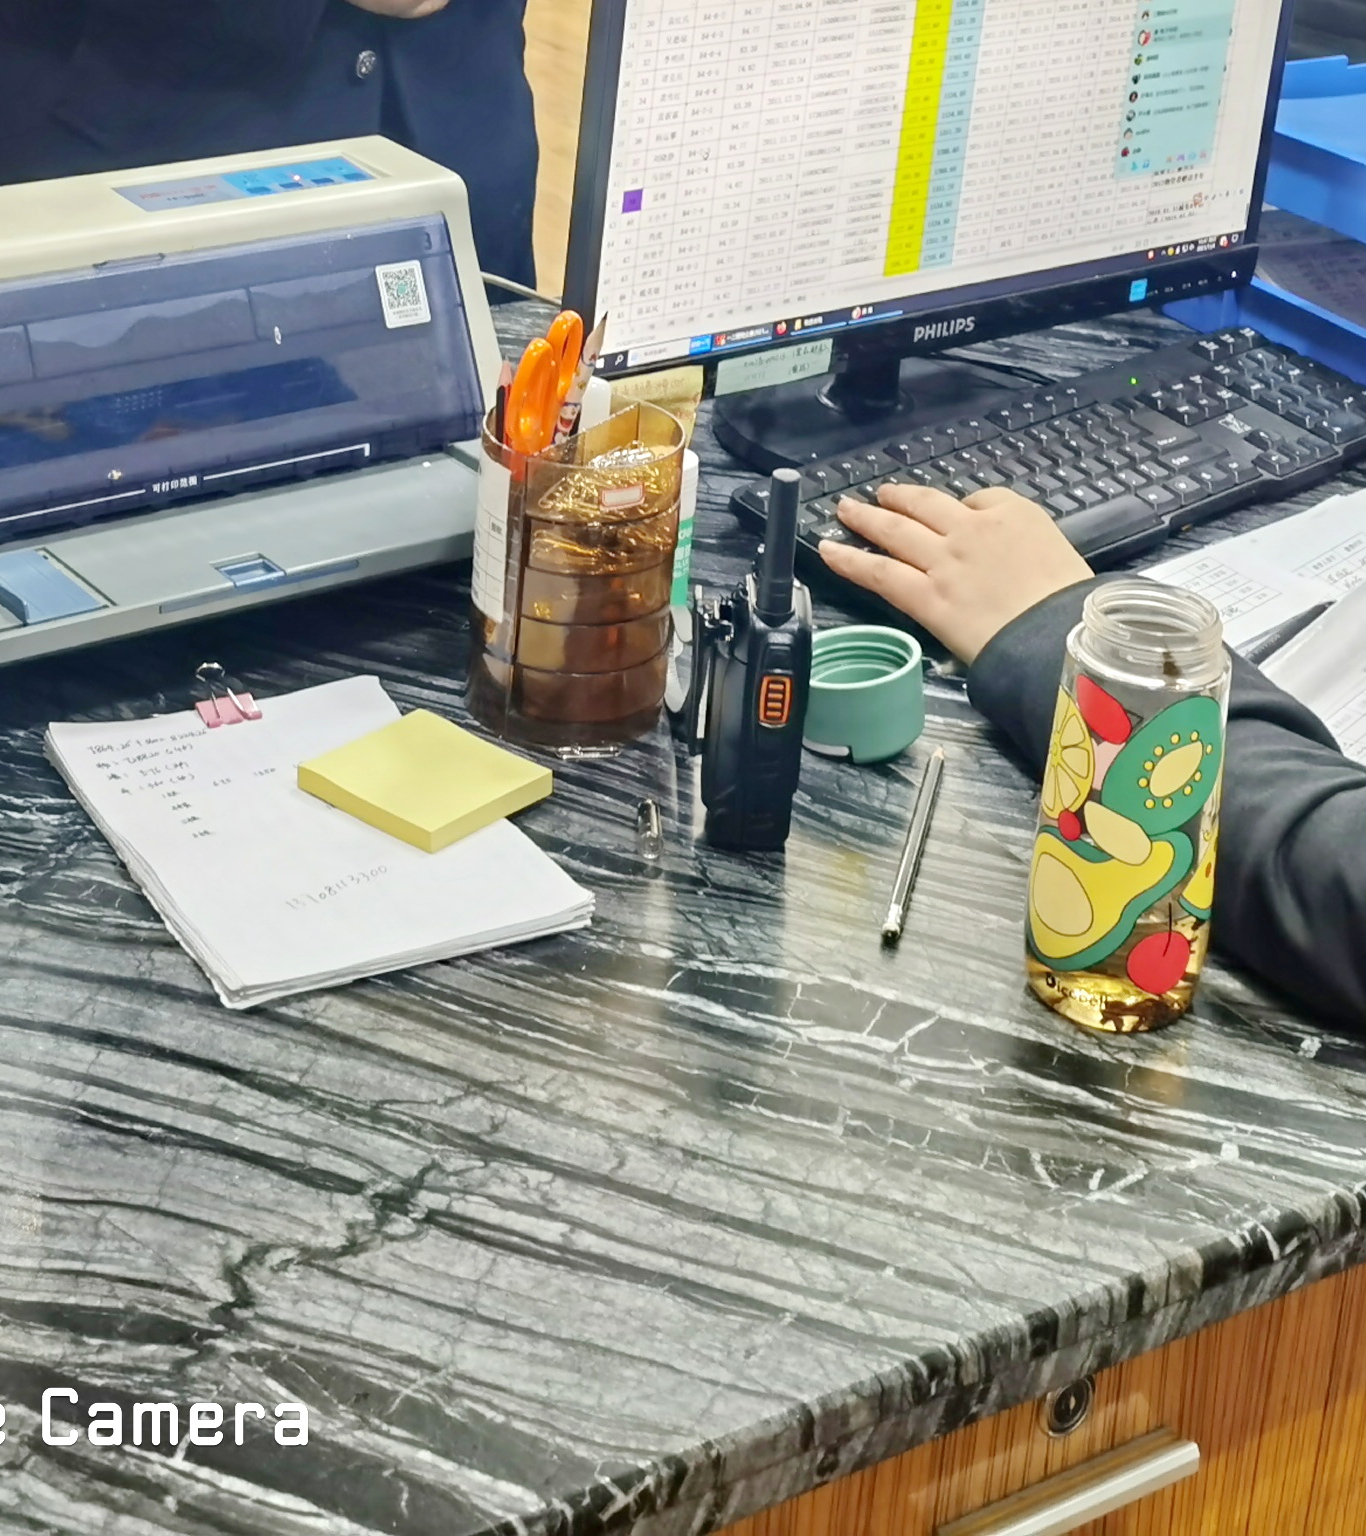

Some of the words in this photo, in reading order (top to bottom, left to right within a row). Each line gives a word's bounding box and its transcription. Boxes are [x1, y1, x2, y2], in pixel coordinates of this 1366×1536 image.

[913, 315, 976, 343] PHILIPS
[152, 475, 197, 493] 可打印范围
